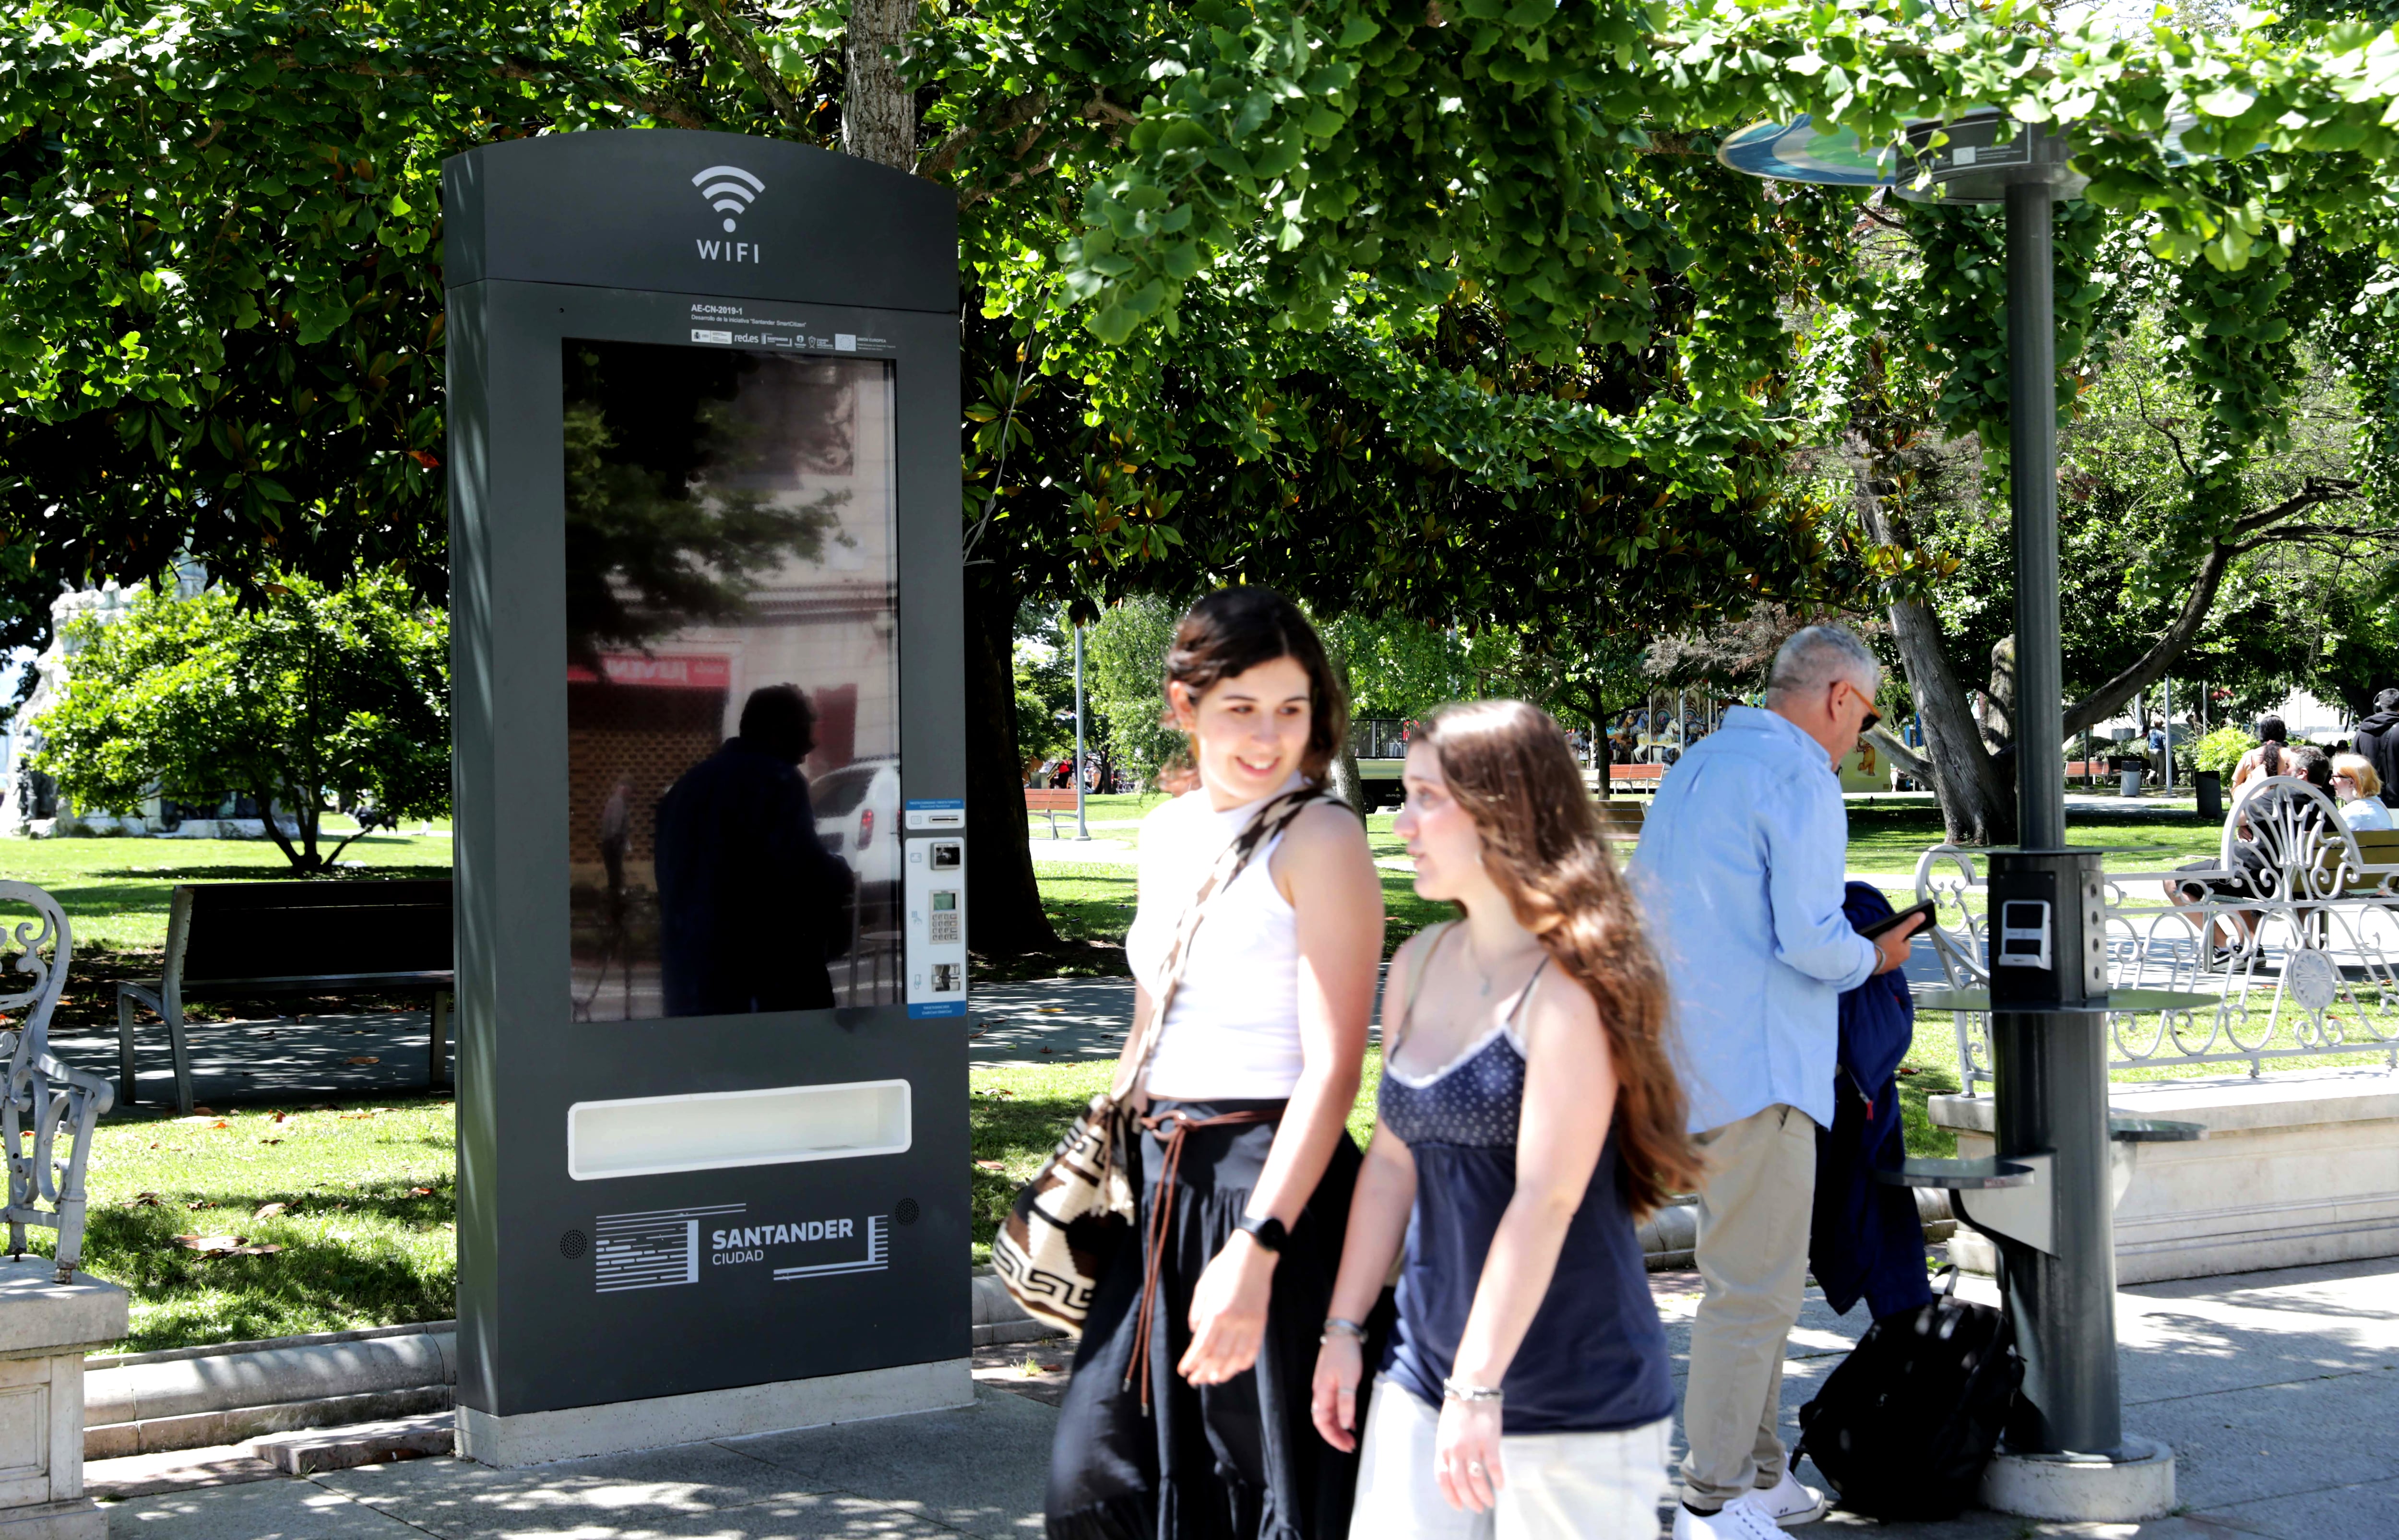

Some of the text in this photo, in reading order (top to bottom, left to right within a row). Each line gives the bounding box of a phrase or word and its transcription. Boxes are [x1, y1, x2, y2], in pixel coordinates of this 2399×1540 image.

[696, 239, 759, 263] WIFI
[691, 304, 742, 315] AE-CN-2019-1
[734, 333, 759, 343] red.es
[713, 1219, 853, 1250] SANTANDER
[713, 1249, 764, 1265] CIUDAD
